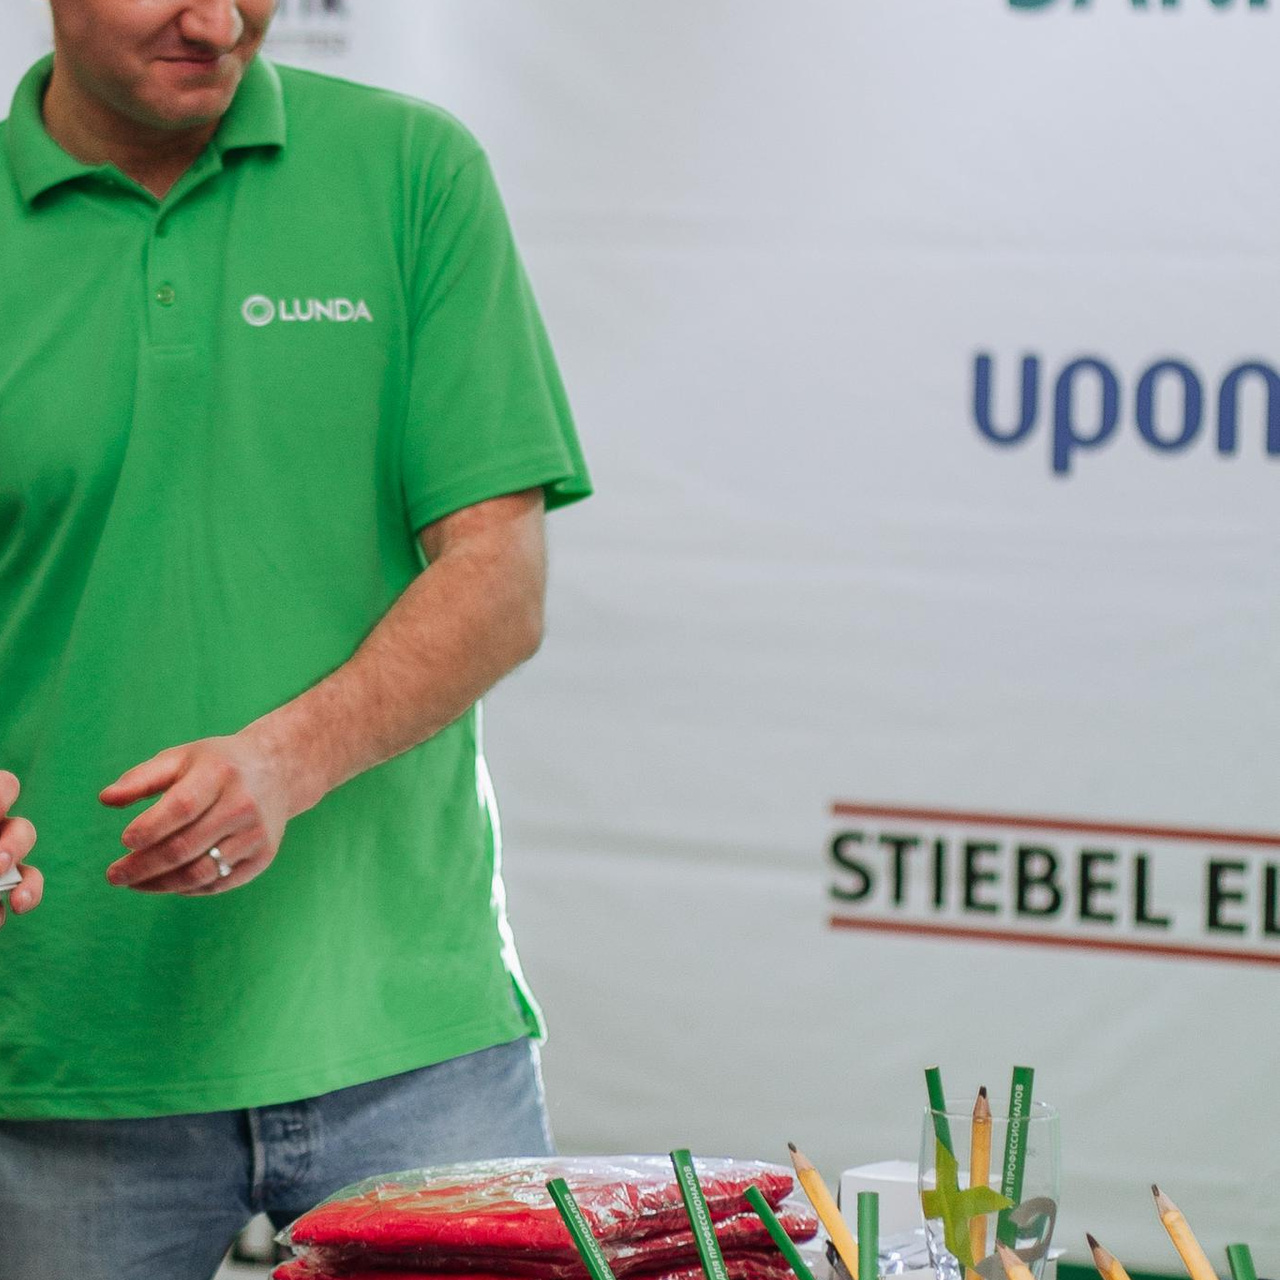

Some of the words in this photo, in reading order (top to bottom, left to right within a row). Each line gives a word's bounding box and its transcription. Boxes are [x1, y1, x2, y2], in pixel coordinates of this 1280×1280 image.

[278, 298, 373, 322] LUNDA
[972, 353, 1280, 475] upon
[829, 830, 1171, 930] STIEBEL
[1006, 1083, 1024, 1184] ПРОФЕССИОНАЛОВ
[683, 1165, 718, 1260] ПРОФЕССИОНАЛОВ
